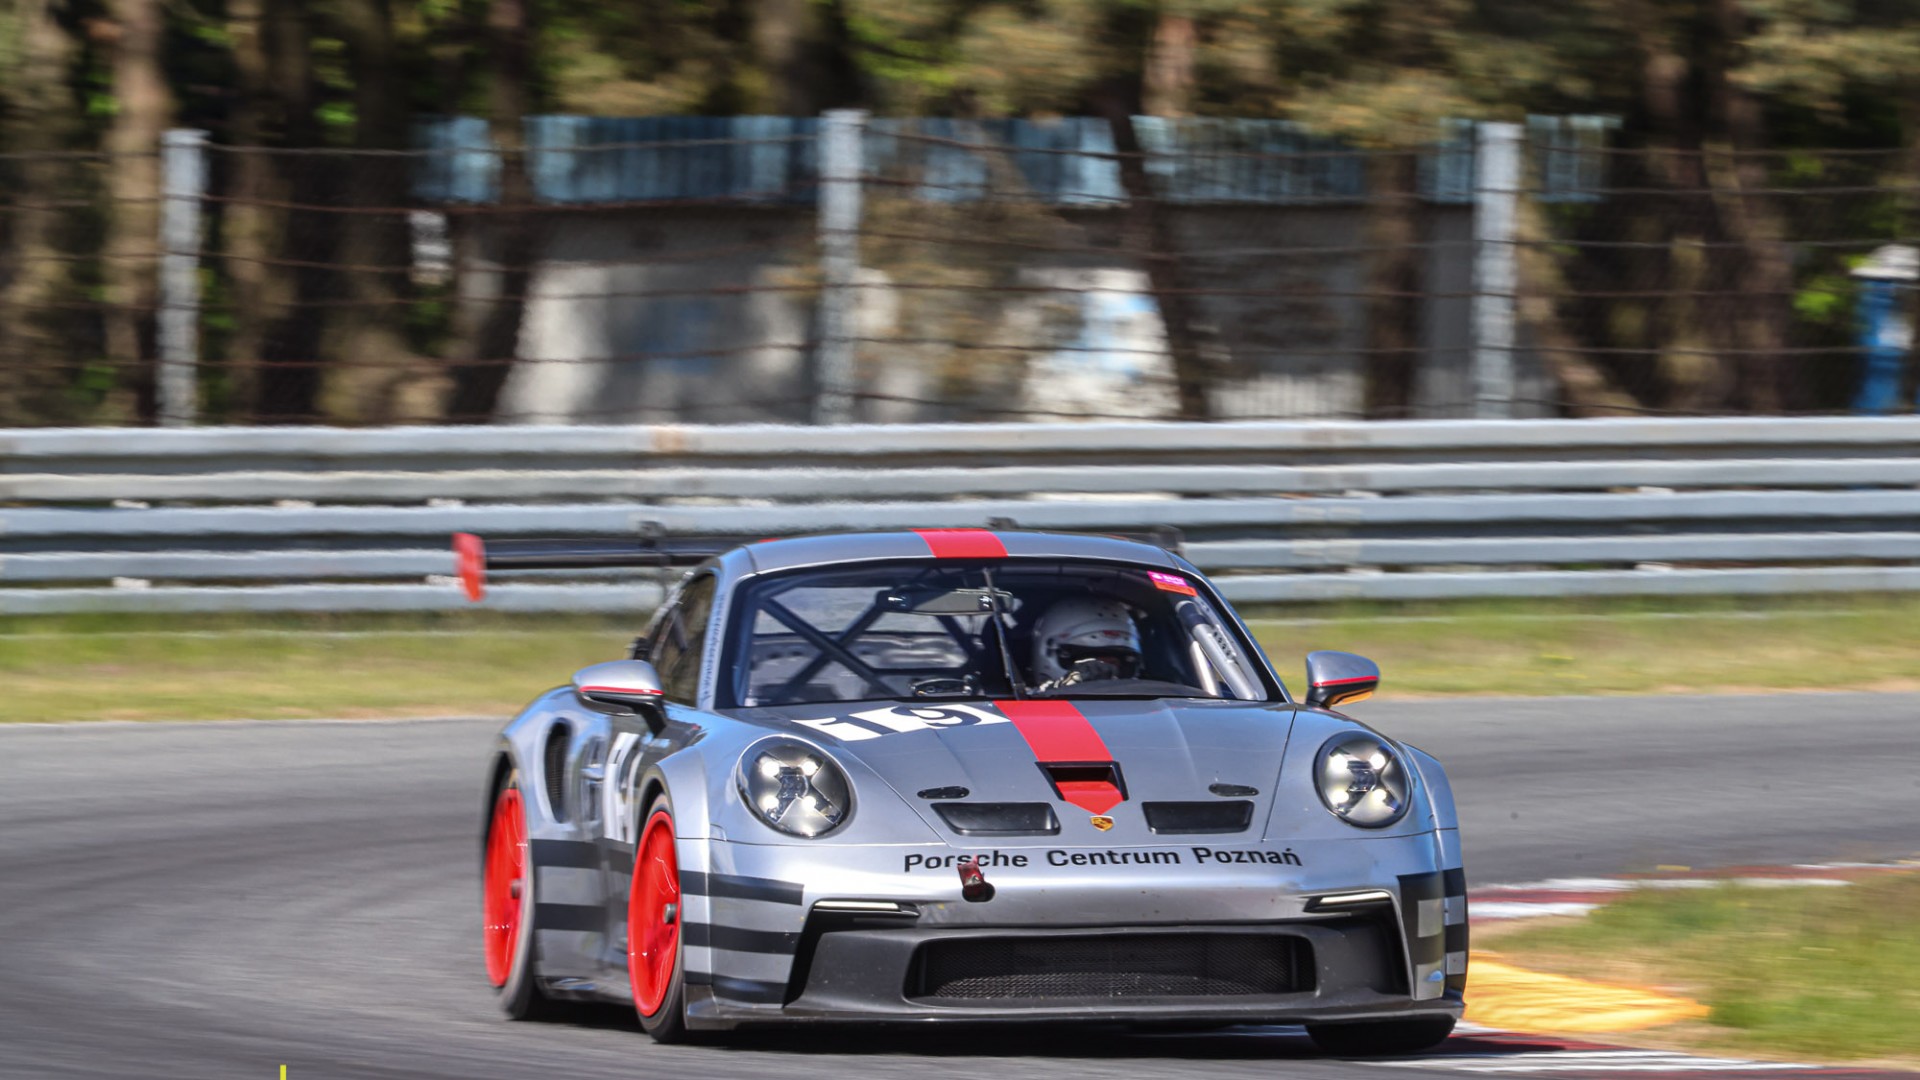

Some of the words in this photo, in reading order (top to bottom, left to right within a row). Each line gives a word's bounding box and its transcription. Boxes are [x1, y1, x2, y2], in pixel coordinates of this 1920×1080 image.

[820, 705, 982, 736] 19
[1047, 849, 1182, 866] Centrum
[1191, 847, 1303, 867] Poznań
